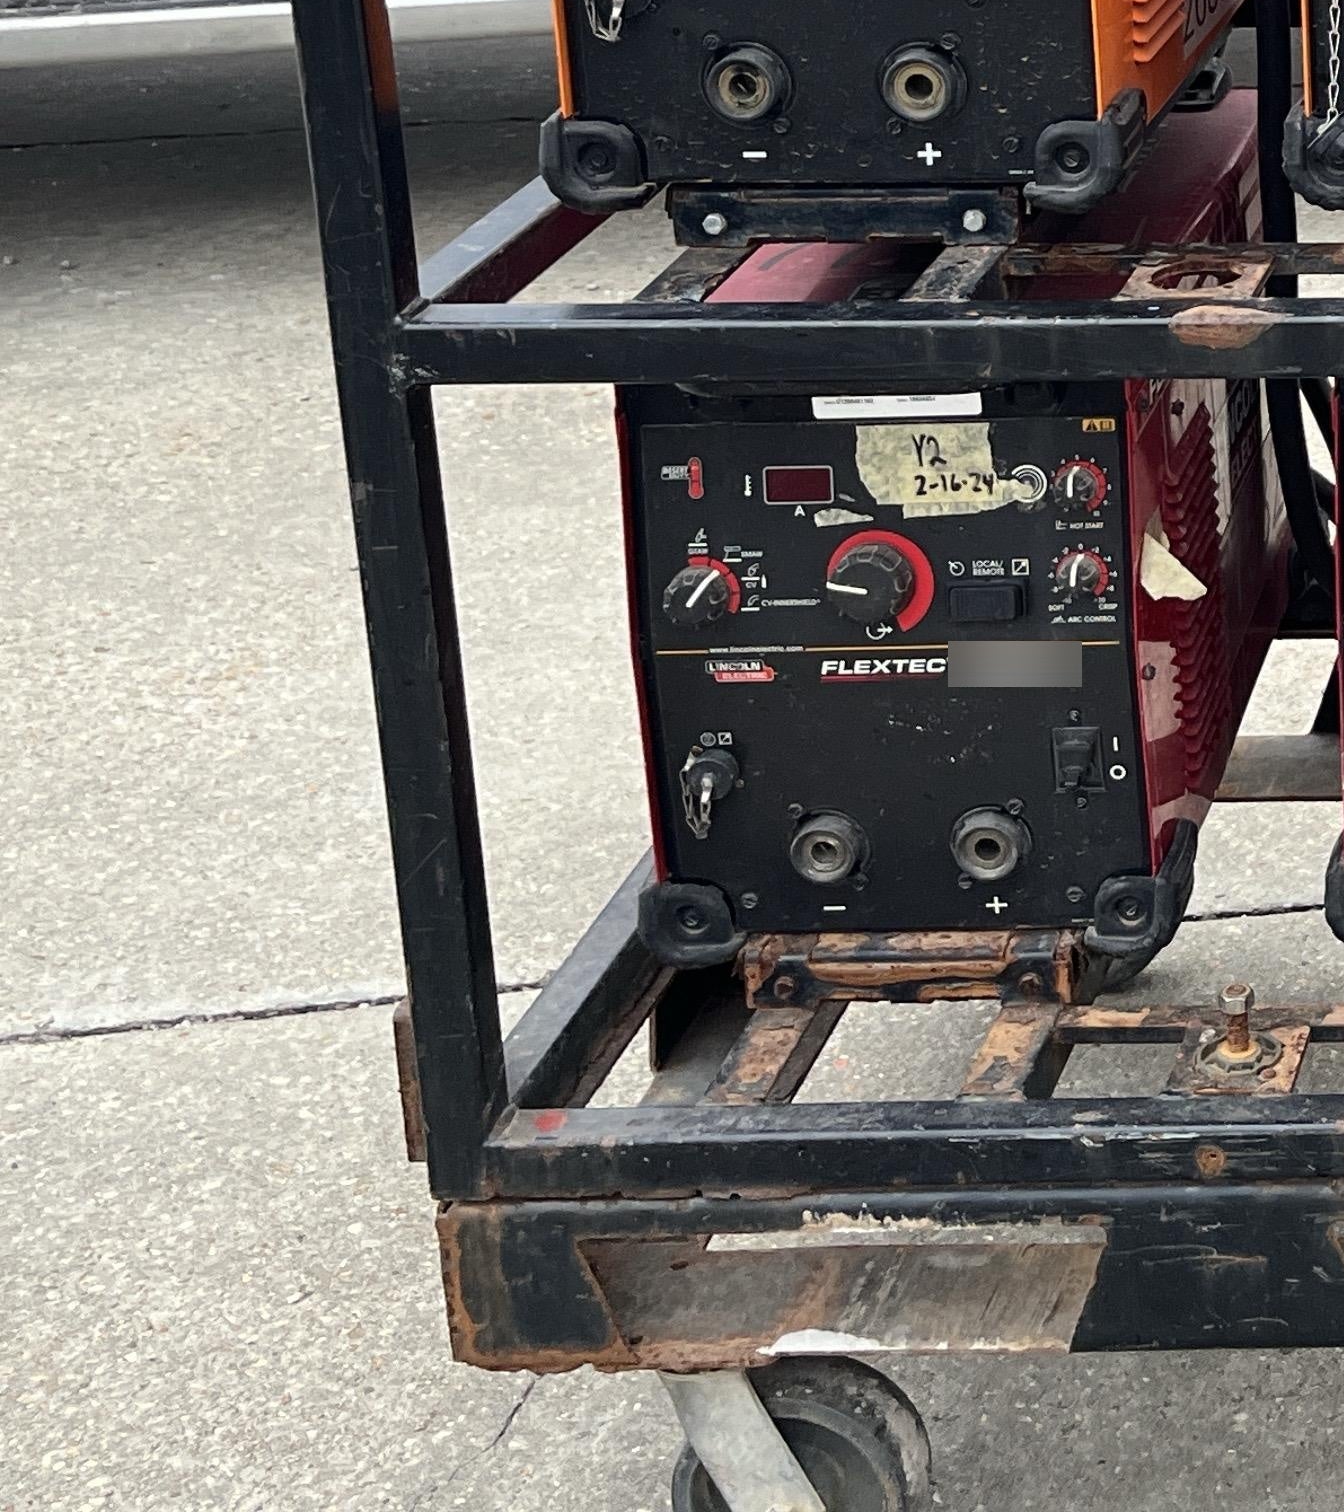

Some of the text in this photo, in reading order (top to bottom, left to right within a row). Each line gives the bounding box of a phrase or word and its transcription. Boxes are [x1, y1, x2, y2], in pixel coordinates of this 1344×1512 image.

[794, 506, 805, 516] A
[709, 662, 760, 671] LINCOLN
[821, 657, 946, 675] FLEXTEC
